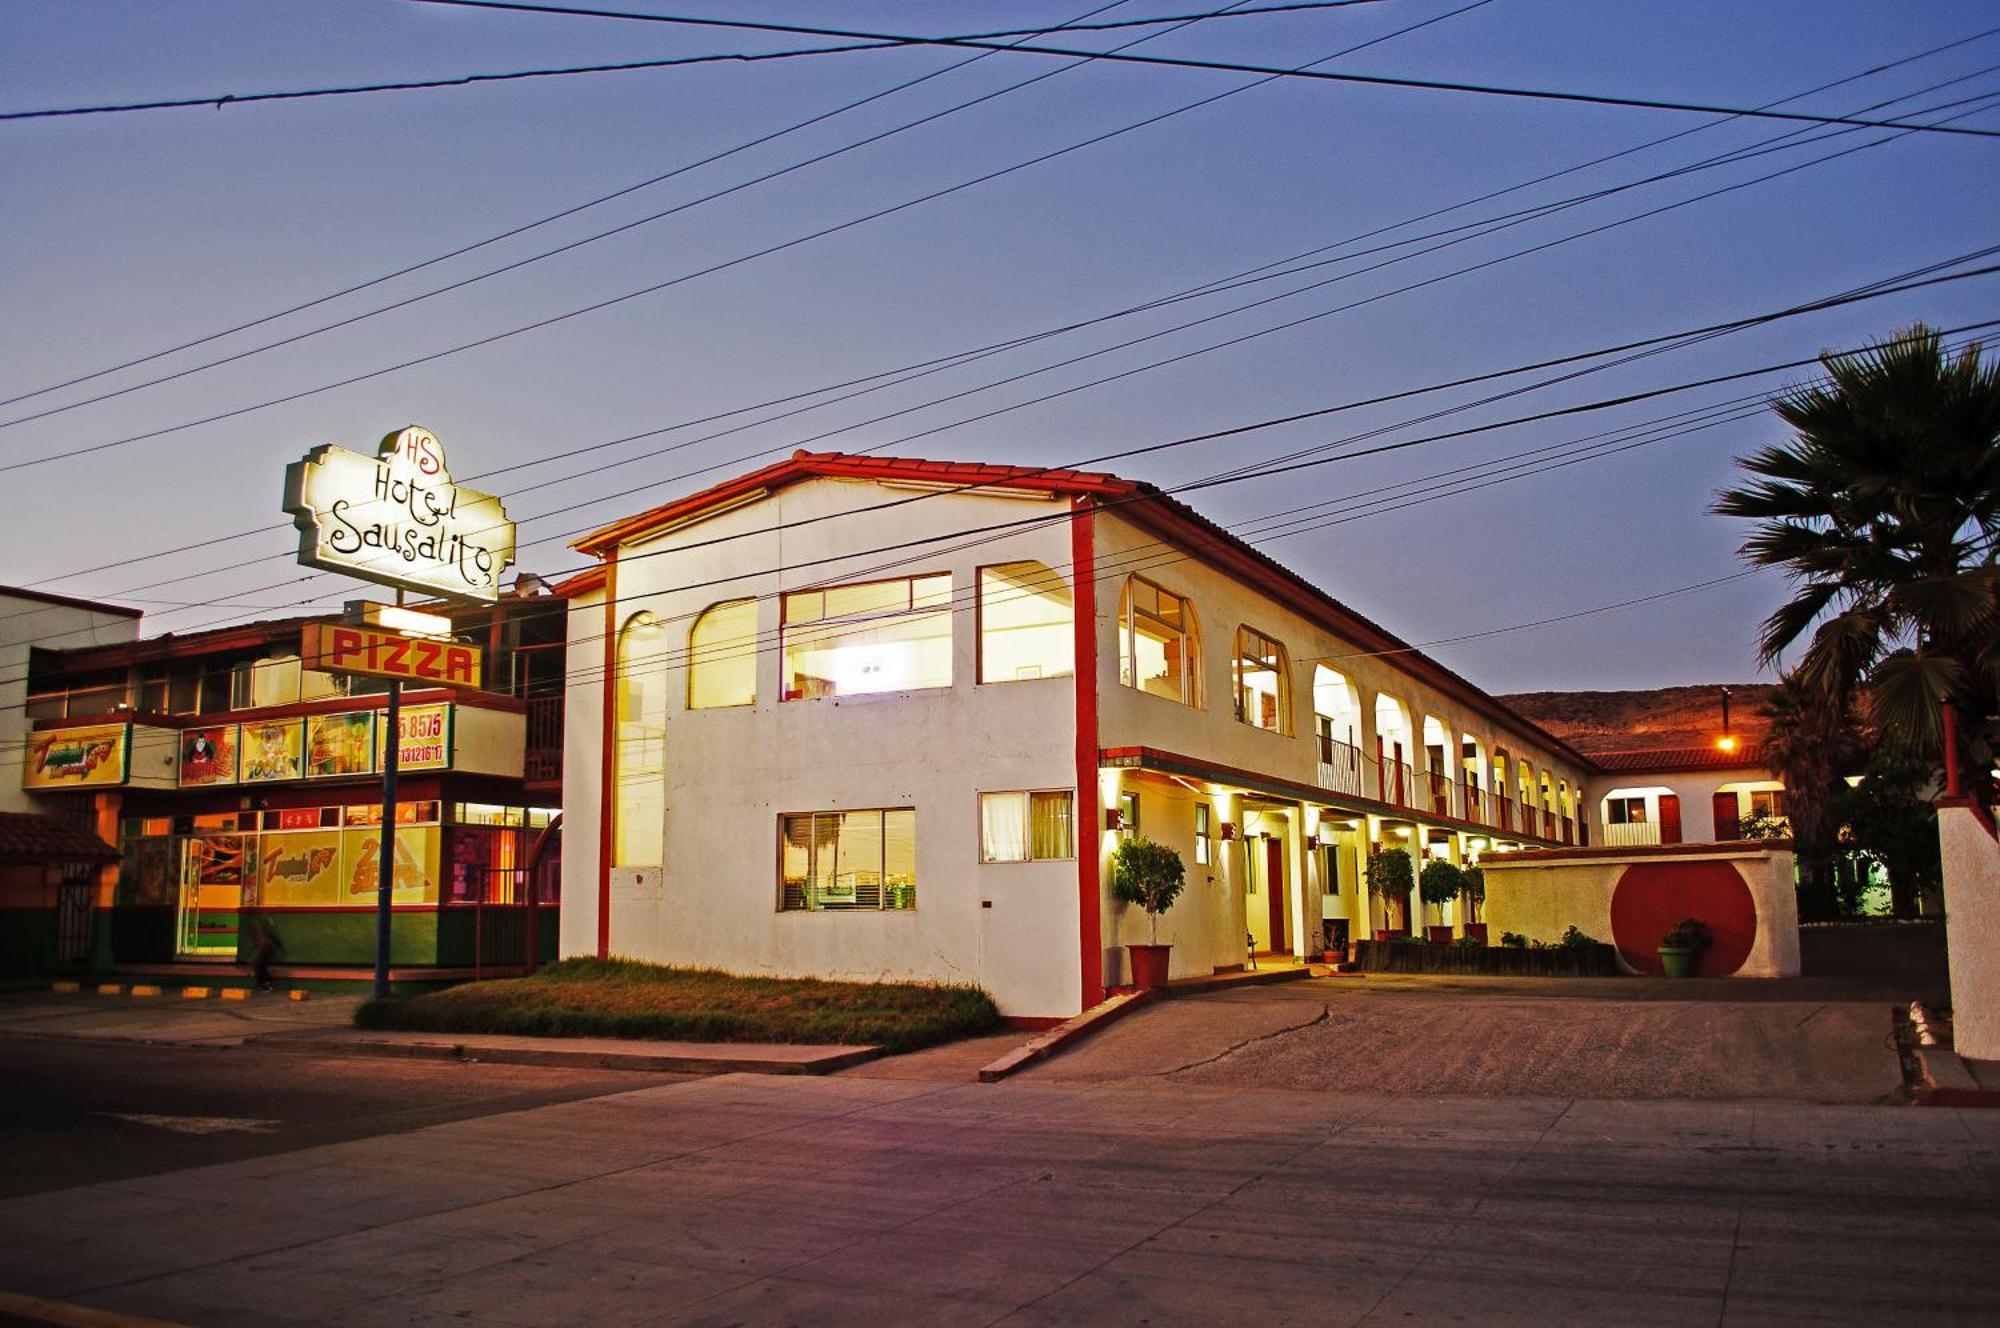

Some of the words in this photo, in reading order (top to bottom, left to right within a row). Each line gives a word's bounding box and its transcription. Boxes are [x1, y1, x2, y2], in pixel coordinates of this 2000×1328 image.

[407, 432, 440, 475] HS
[375, 464, 458, 527] Hotel
[330, 499, 493, 586] Sausalito
[333, 628, 473, 683] PIZZA
[410, 713, 441, 738] 8575
